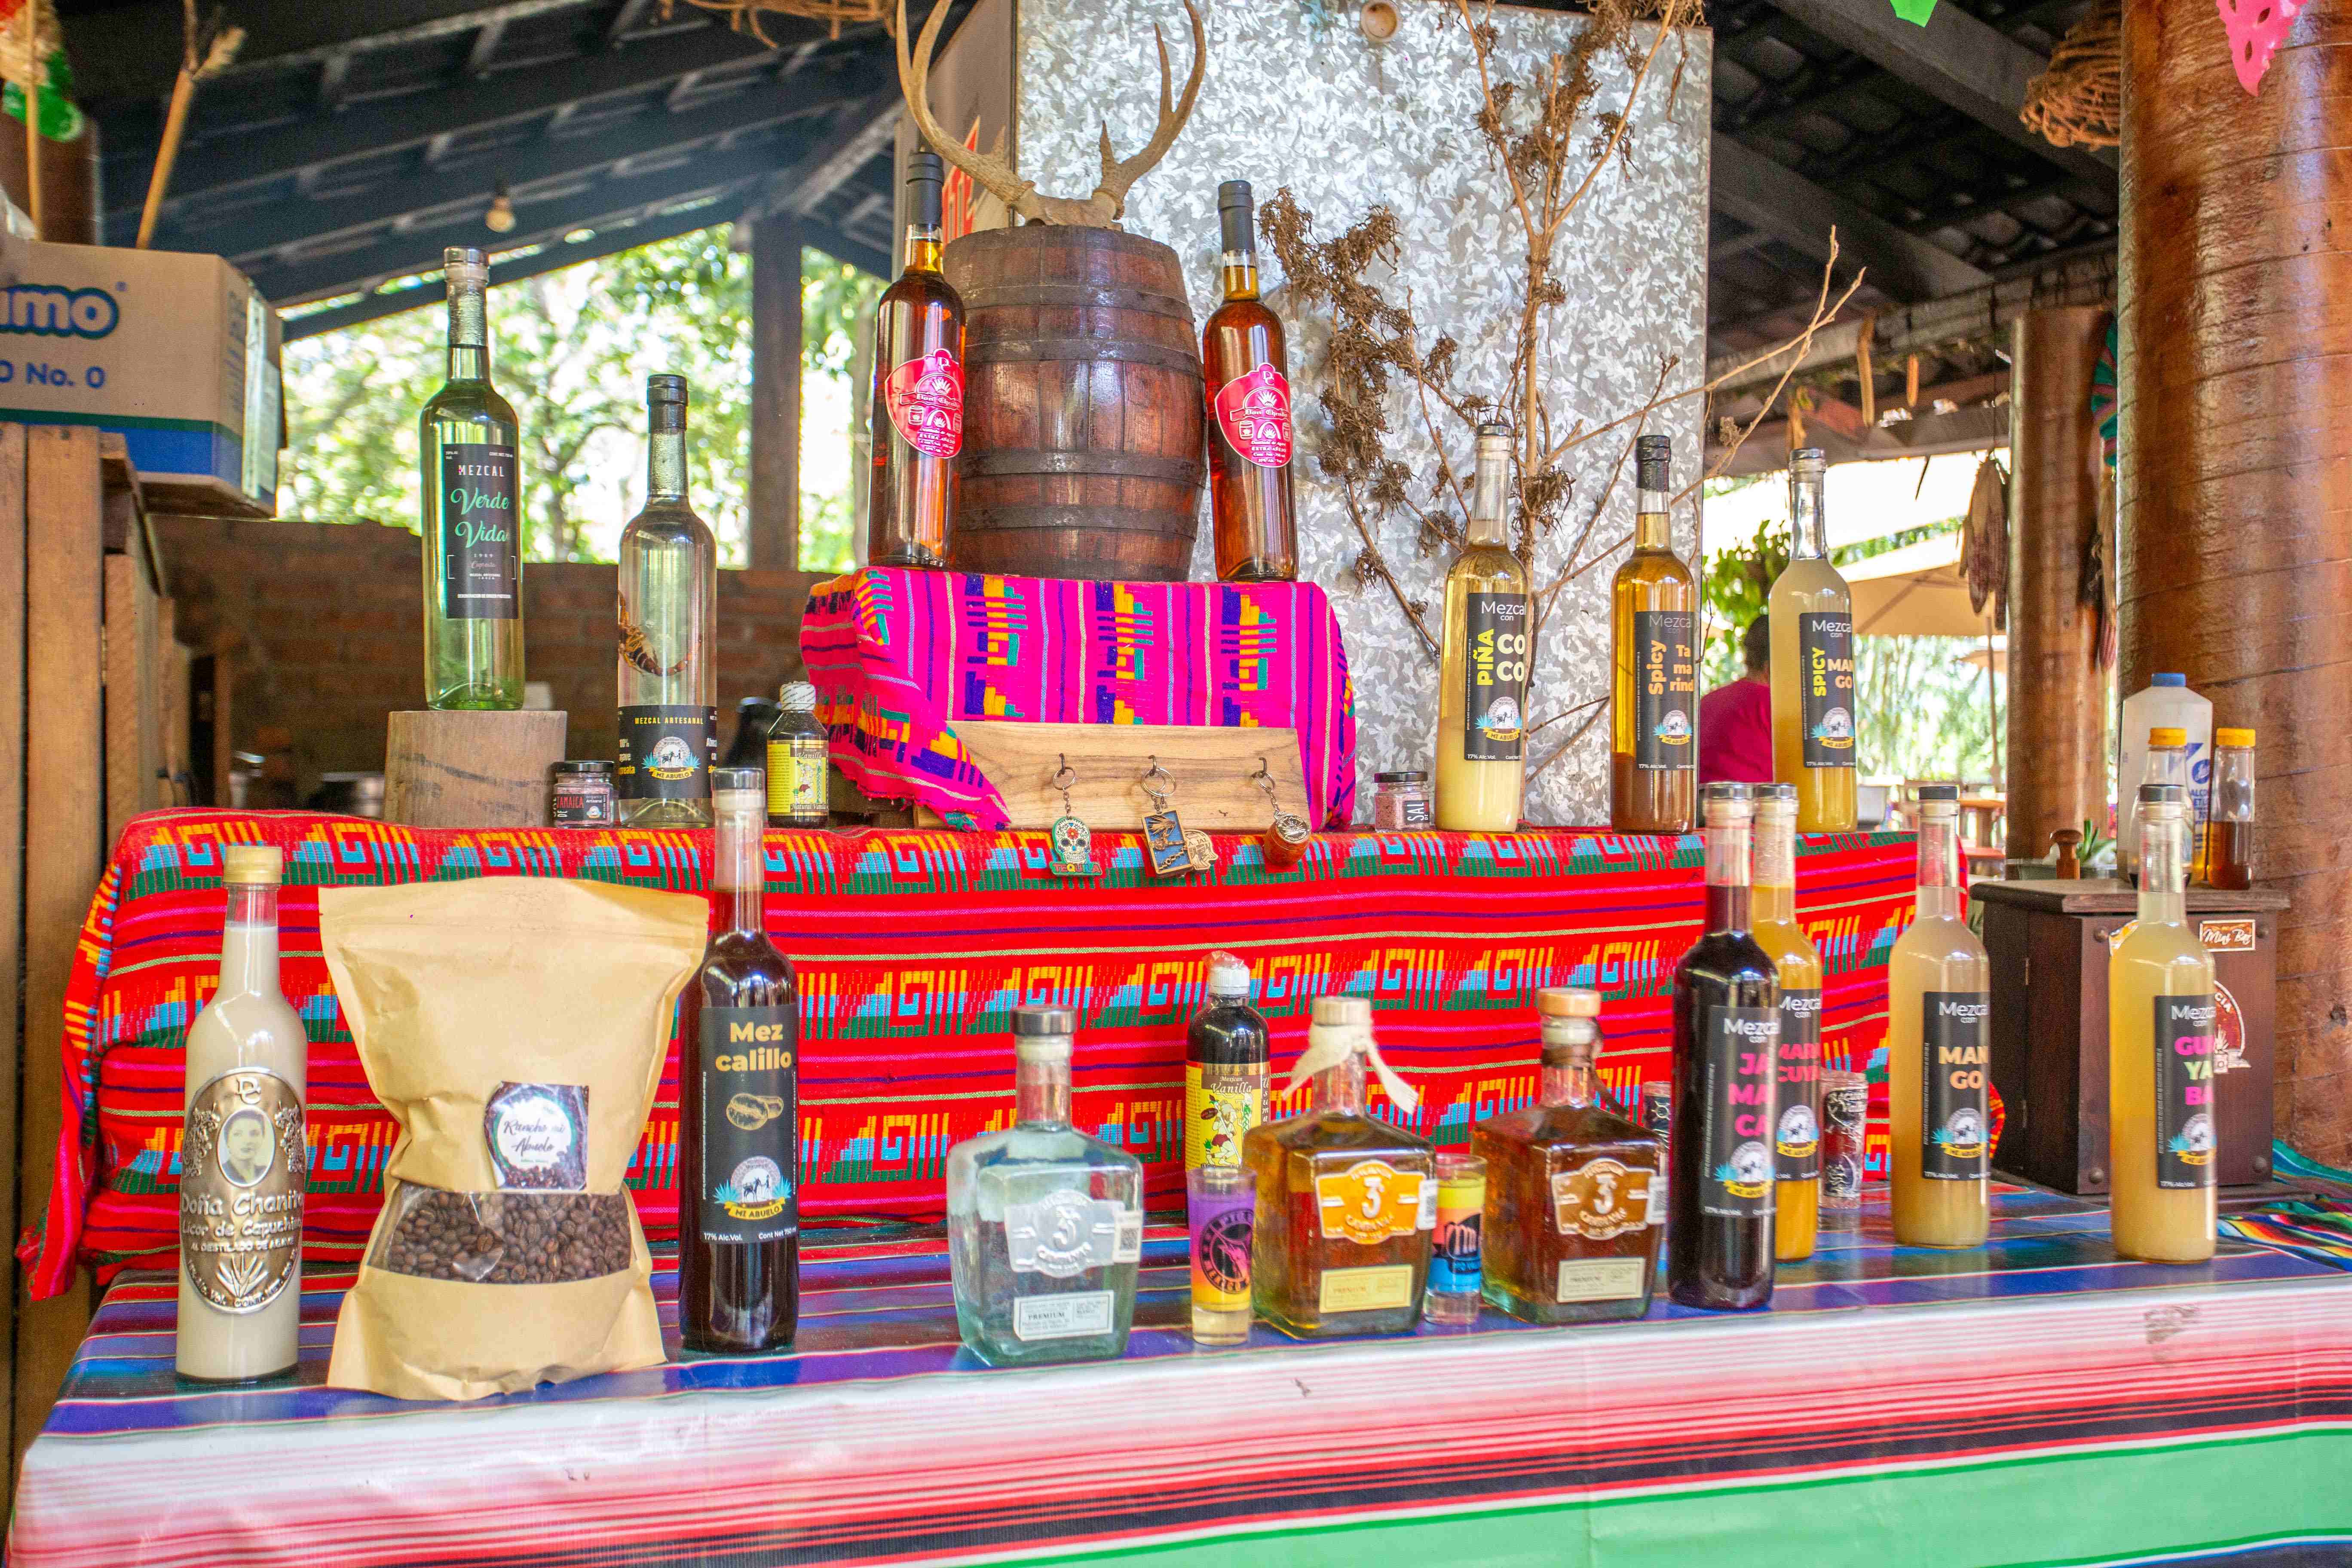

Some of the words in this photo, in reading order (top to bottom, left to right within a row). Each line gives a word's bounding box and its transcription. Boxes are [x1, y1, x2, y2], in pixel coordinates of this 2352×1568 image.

[0, 284, 119, 339] mo
[26, 363, 75, 386] No.
[458, 465, 505, 477] MEZCAL
[450, 487, 509, 514] Verde
[455, 520, 509, 548] Vida
[1481, 601, 1526, 616] Mezcal
[1649, 615, 1693, 628] Mezca
[1812, 620, 1852, 632] Mezca
[1497, 634, 1526, 655] CO
[1675, 644, 1691, 658] Ta
[1473, 628, 1494, 686] PIÑA
[1496, 661, 1525, 682] CO
[1646, 640, 1667, 695] Spicy
[1673, 664, 1693, 675] ma
[1812, 646, 1827, 697] SPICY
[1669, 677, 1694, 692] rind
[1835, 675, 1853, 689] GO
[1407, 802, 1424, 821] SAL
[1052, 863, 1101, 873] TEQUILA
[729, 1021, 784, 1043] Mez
[2174, 1036, 2214, 1056] GU
[715, 1047, 792, 1072] calillo
[1950, 1070, 1984, 1090] GO
[2184, 1061, 2214, 1080] YA
[1210, 1081, 1253, 1094] Vanilla
[2184, 1086, 2214, 1106] BA
[1735, 1114, 1770, 1137] CA
[181, 1191, 223, 1216] Doña
[748, 1206, 780, 1218] ABUELO
[214, 1220, 235, 1237] de
[704, 1232, 717, 1241] 17%
[758, 1231, 774, 1240] Cont
[1028, 1311, 1066, 1321] PREMIUM
